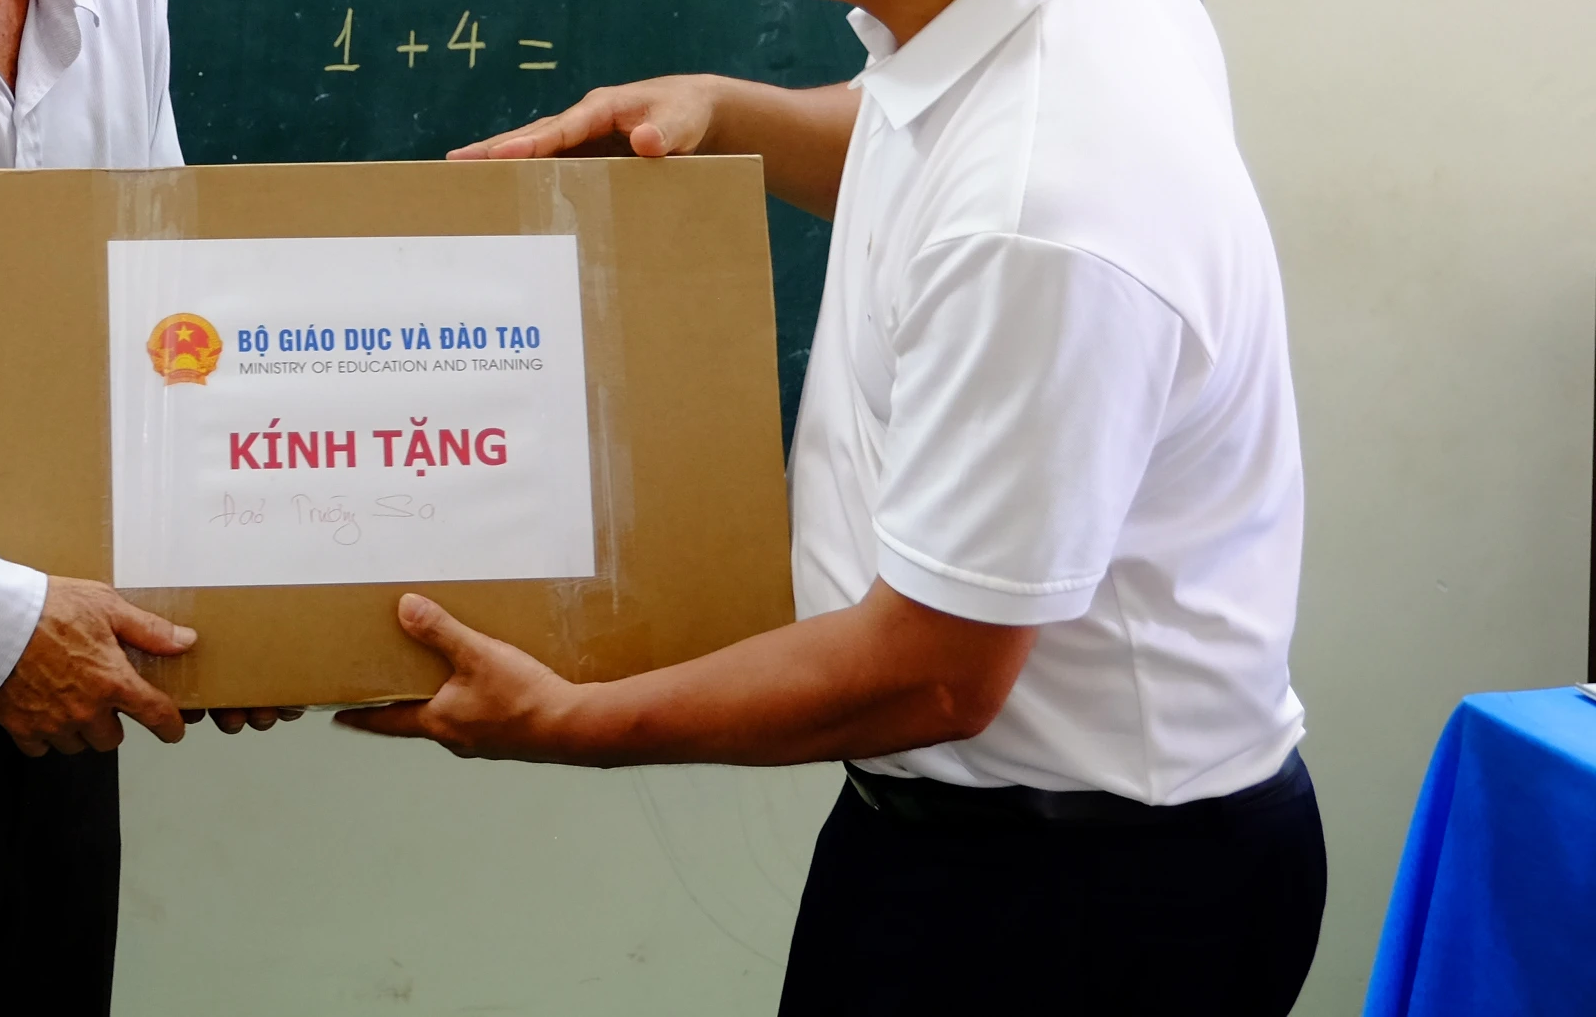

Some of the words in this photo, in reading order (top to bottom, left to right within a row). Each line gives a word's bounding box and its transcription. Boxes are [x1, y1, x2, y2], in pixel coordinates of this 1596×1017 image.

[324, 8, 360, 71] 1
[447, 11, 486, 68] 4
[237, 324, 269, 357] BỘ
[278, 324, 335, 352] GIÁO
[345, 327, 392, 356] DỤC
[400, 323, 431, 350] VÀ
[440, 322, 487, 349] ĐÀO
[496, 326, 540, 353] TẠO
[239, 361, 306, 375] MINISTRY
[311, 360, 333, 374] OF
[338, 359, 428, 374] EDUCATION
[432, 359, 467, 372] AND
[471, 358, 544, 372] TRAINING
[229, 417, 356, 470] KÍNH
[372, 416, 507, 477] TẶNG
